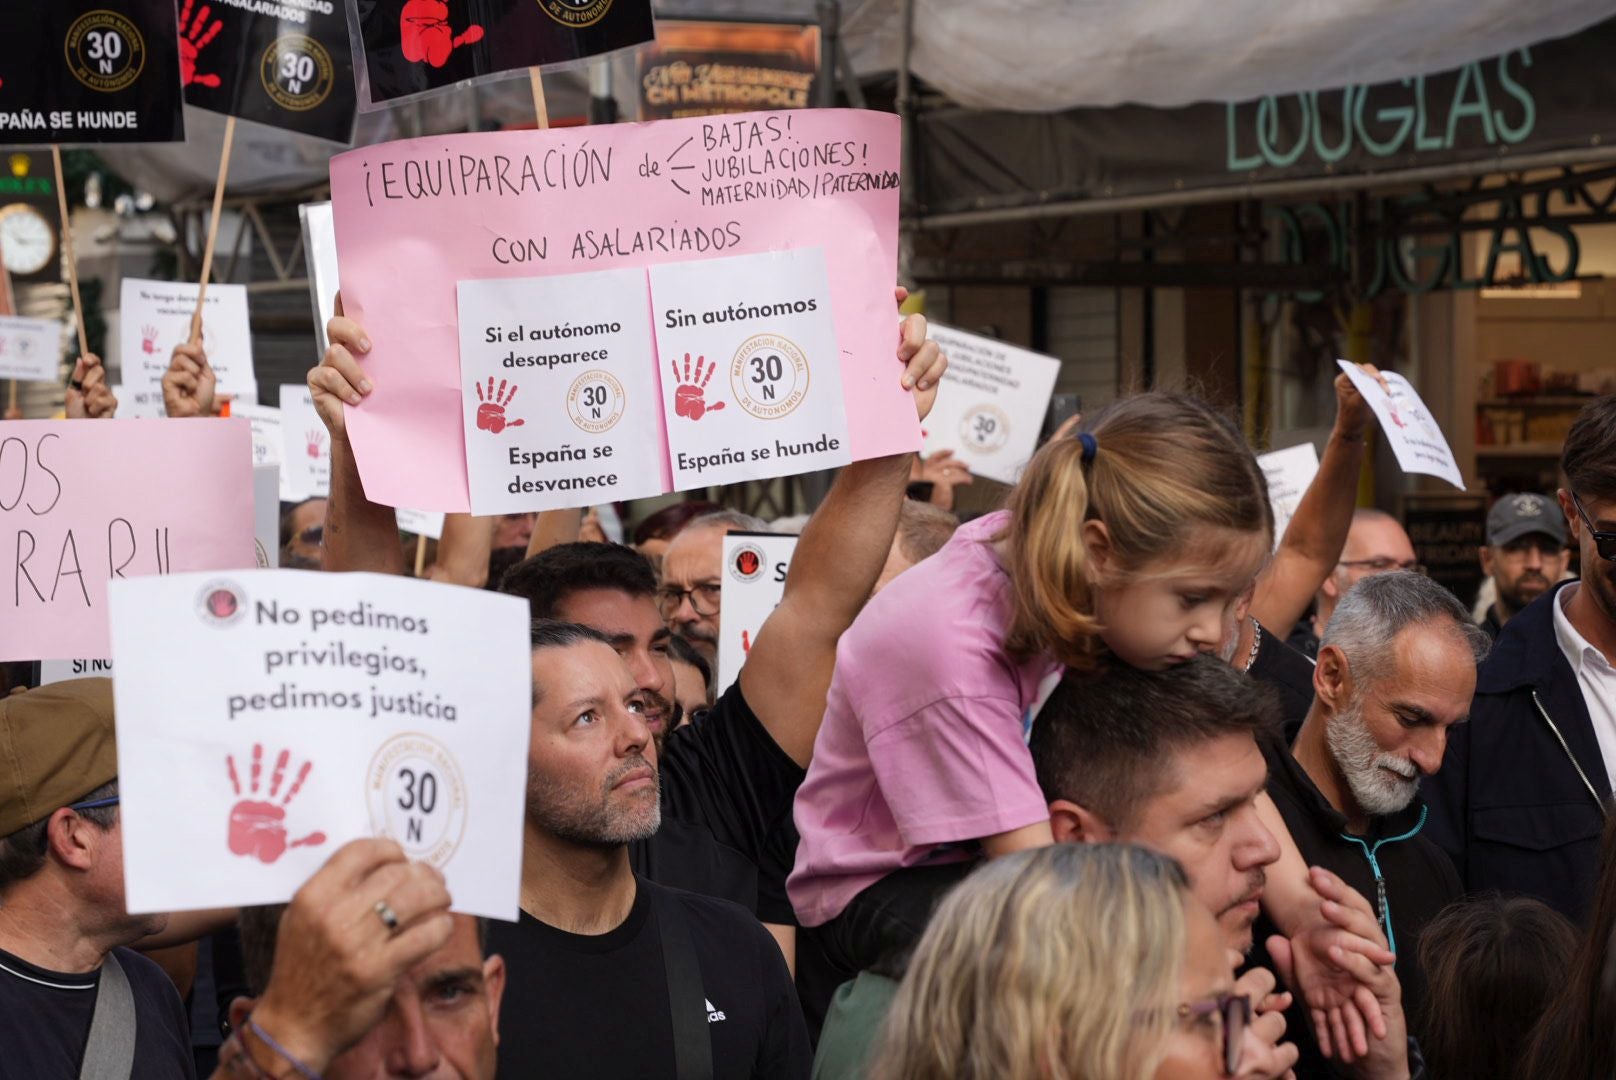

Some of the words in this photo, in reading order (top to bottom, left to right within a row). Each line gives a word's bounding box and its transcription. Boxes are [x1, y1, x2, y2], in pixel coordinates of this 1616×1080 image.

[87, 31, 122, 59] 30
[99, 59, 113, 74] N
[281, 52, 314, 82] 30
[288, 78, 302, 95] N
[50, 111, 73, 129] SE
[77, 111, 138, 128] HUNDE
[703, 115, 793, 151] BAJAS!
[639, 152, 661, 178] de
[702, 140, 868, 182] JUBILACIONES!
[492, 237, 547, 264] CON
[572, 220, 741, 260] ASALARIADOS
[665, 309, 696, 328] Sin
[702, 299, 818, 324] autónomos
[485, 326, 502, 343] Si
[507, 325, 524, 342] el
[529, 322, 621, 341] autónomo
[502, 349, 608, 369] desaparece
[750, 354, 783, 384] 30
[583, 385, 607, 407] 30
[762, 384, 775, 400] N
[592, 407, 601, 419] N
[973, 414, 997, 434] 30
[509, 445, 587, 468] España
[593, 445, 613, 459] se
[678, 447, 746, 472] España
[751, 449, 770, 461] se
[775, 433, 840, 458] hunde
[507, 473, 618, 494] desvanece
[255, 601, 300, 625] No
[310, 602, 429, 634] pedimos
[265, 642, 426, 677] privilegios,
[228, 683, 363, 719] pedimos
[370, 687, 457, 721] justicia
[398, 768, 437, 814] 30
[407, 818, 422, 842] N
[707, 1010, 727, 1024] as
